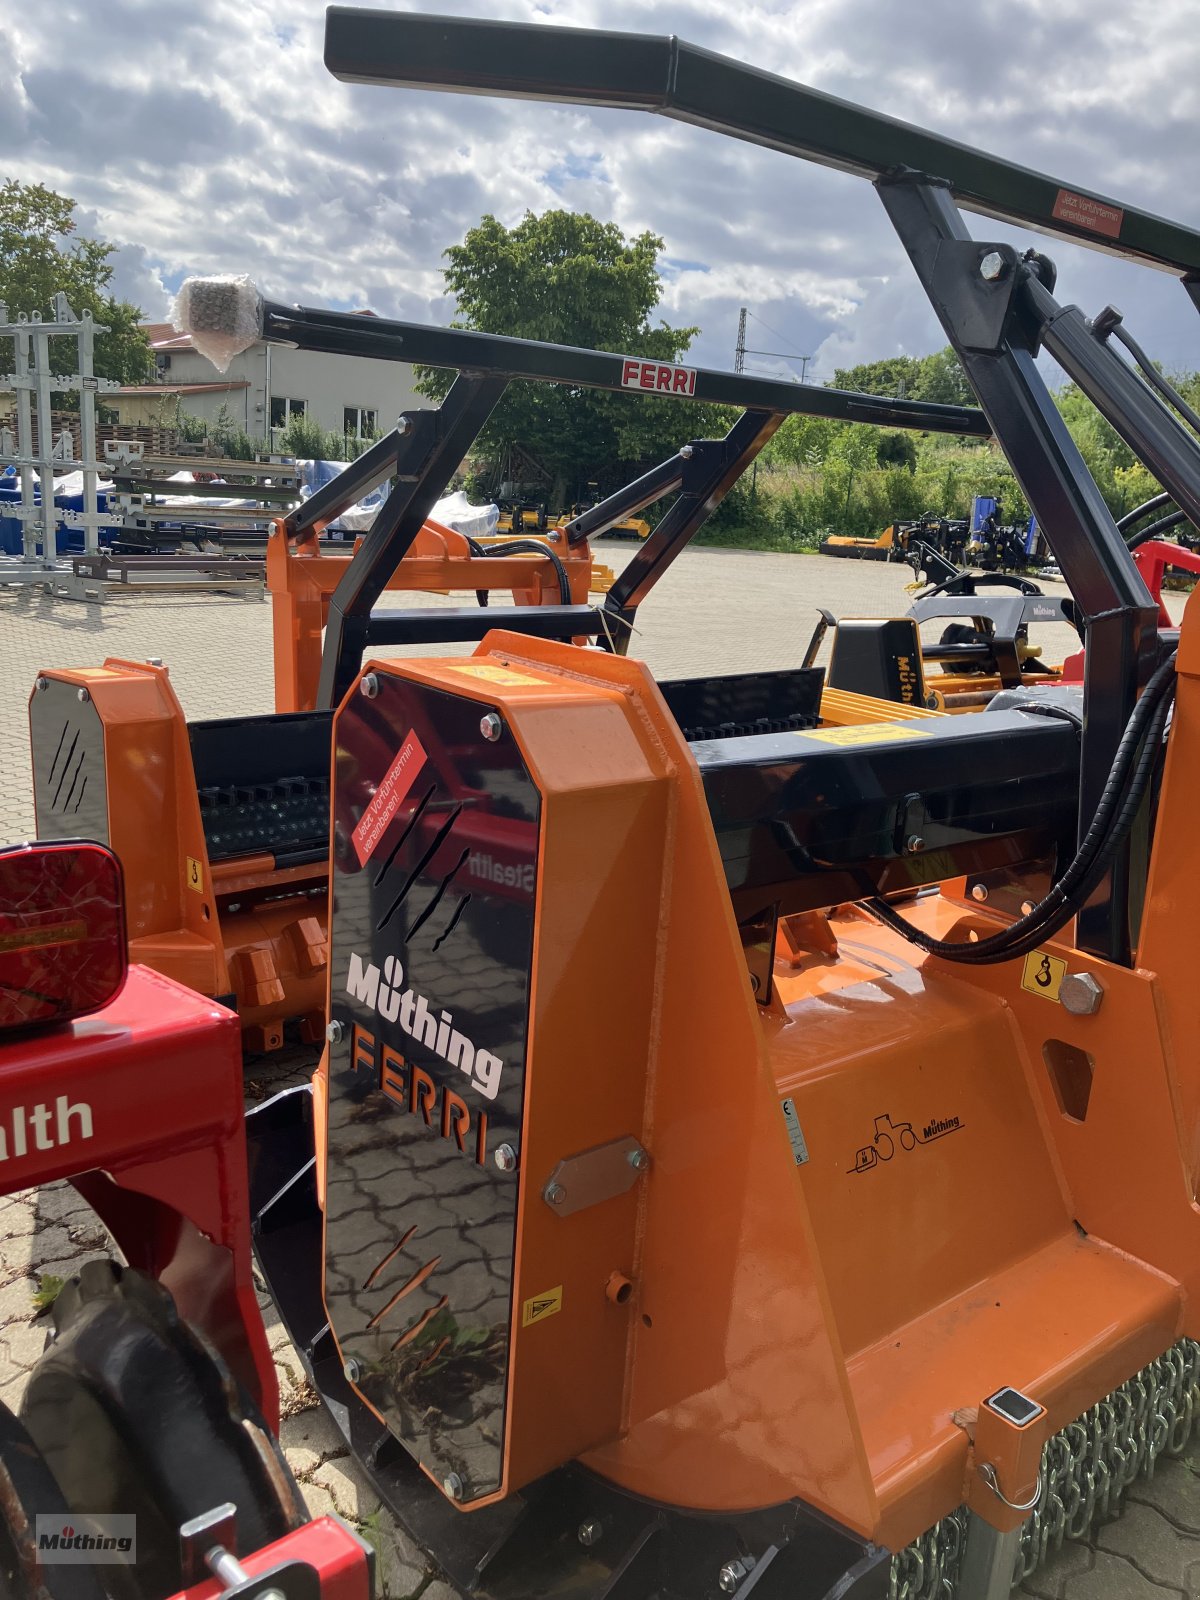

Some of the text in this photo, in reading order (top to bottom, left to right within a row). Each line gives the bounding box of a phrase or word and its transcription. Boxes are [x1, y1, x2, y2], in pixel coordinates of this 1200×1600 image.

[623, 360, 696, 394] FERRI
[897, 656, 917, 704] Müth
[358, 743, 414, 841] Jetzt Vorführtermin
[363, 790, 400, 853] vereinbaren!
[346, 952, 504, 1101] Müthing
[350, 1020, 489, 1167] FERRI
[922, 1116, 960, 1139] Müthing
